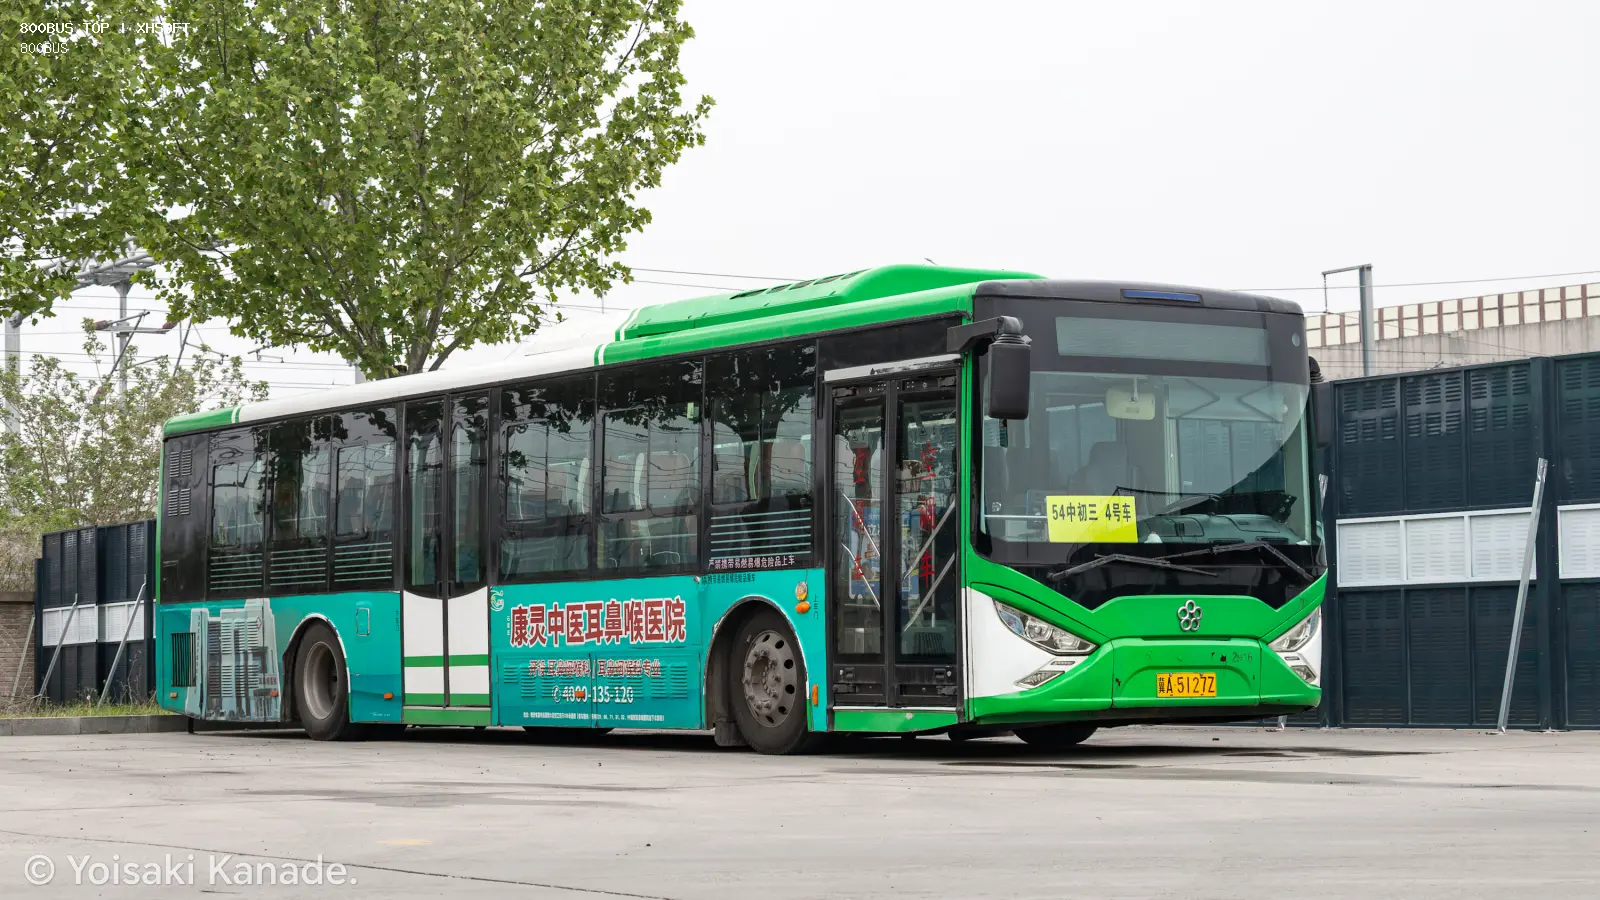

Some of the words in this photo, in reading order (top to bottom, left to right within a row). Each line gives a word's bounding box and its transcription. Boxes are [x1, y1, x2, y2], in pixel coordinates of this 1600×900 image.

[1052, 502, 1098, 522] 54中初三
[1105, 502, 1132, 522] 4号车
[510, 595, 687, 648] 康灵中医耳鼻喉医院
